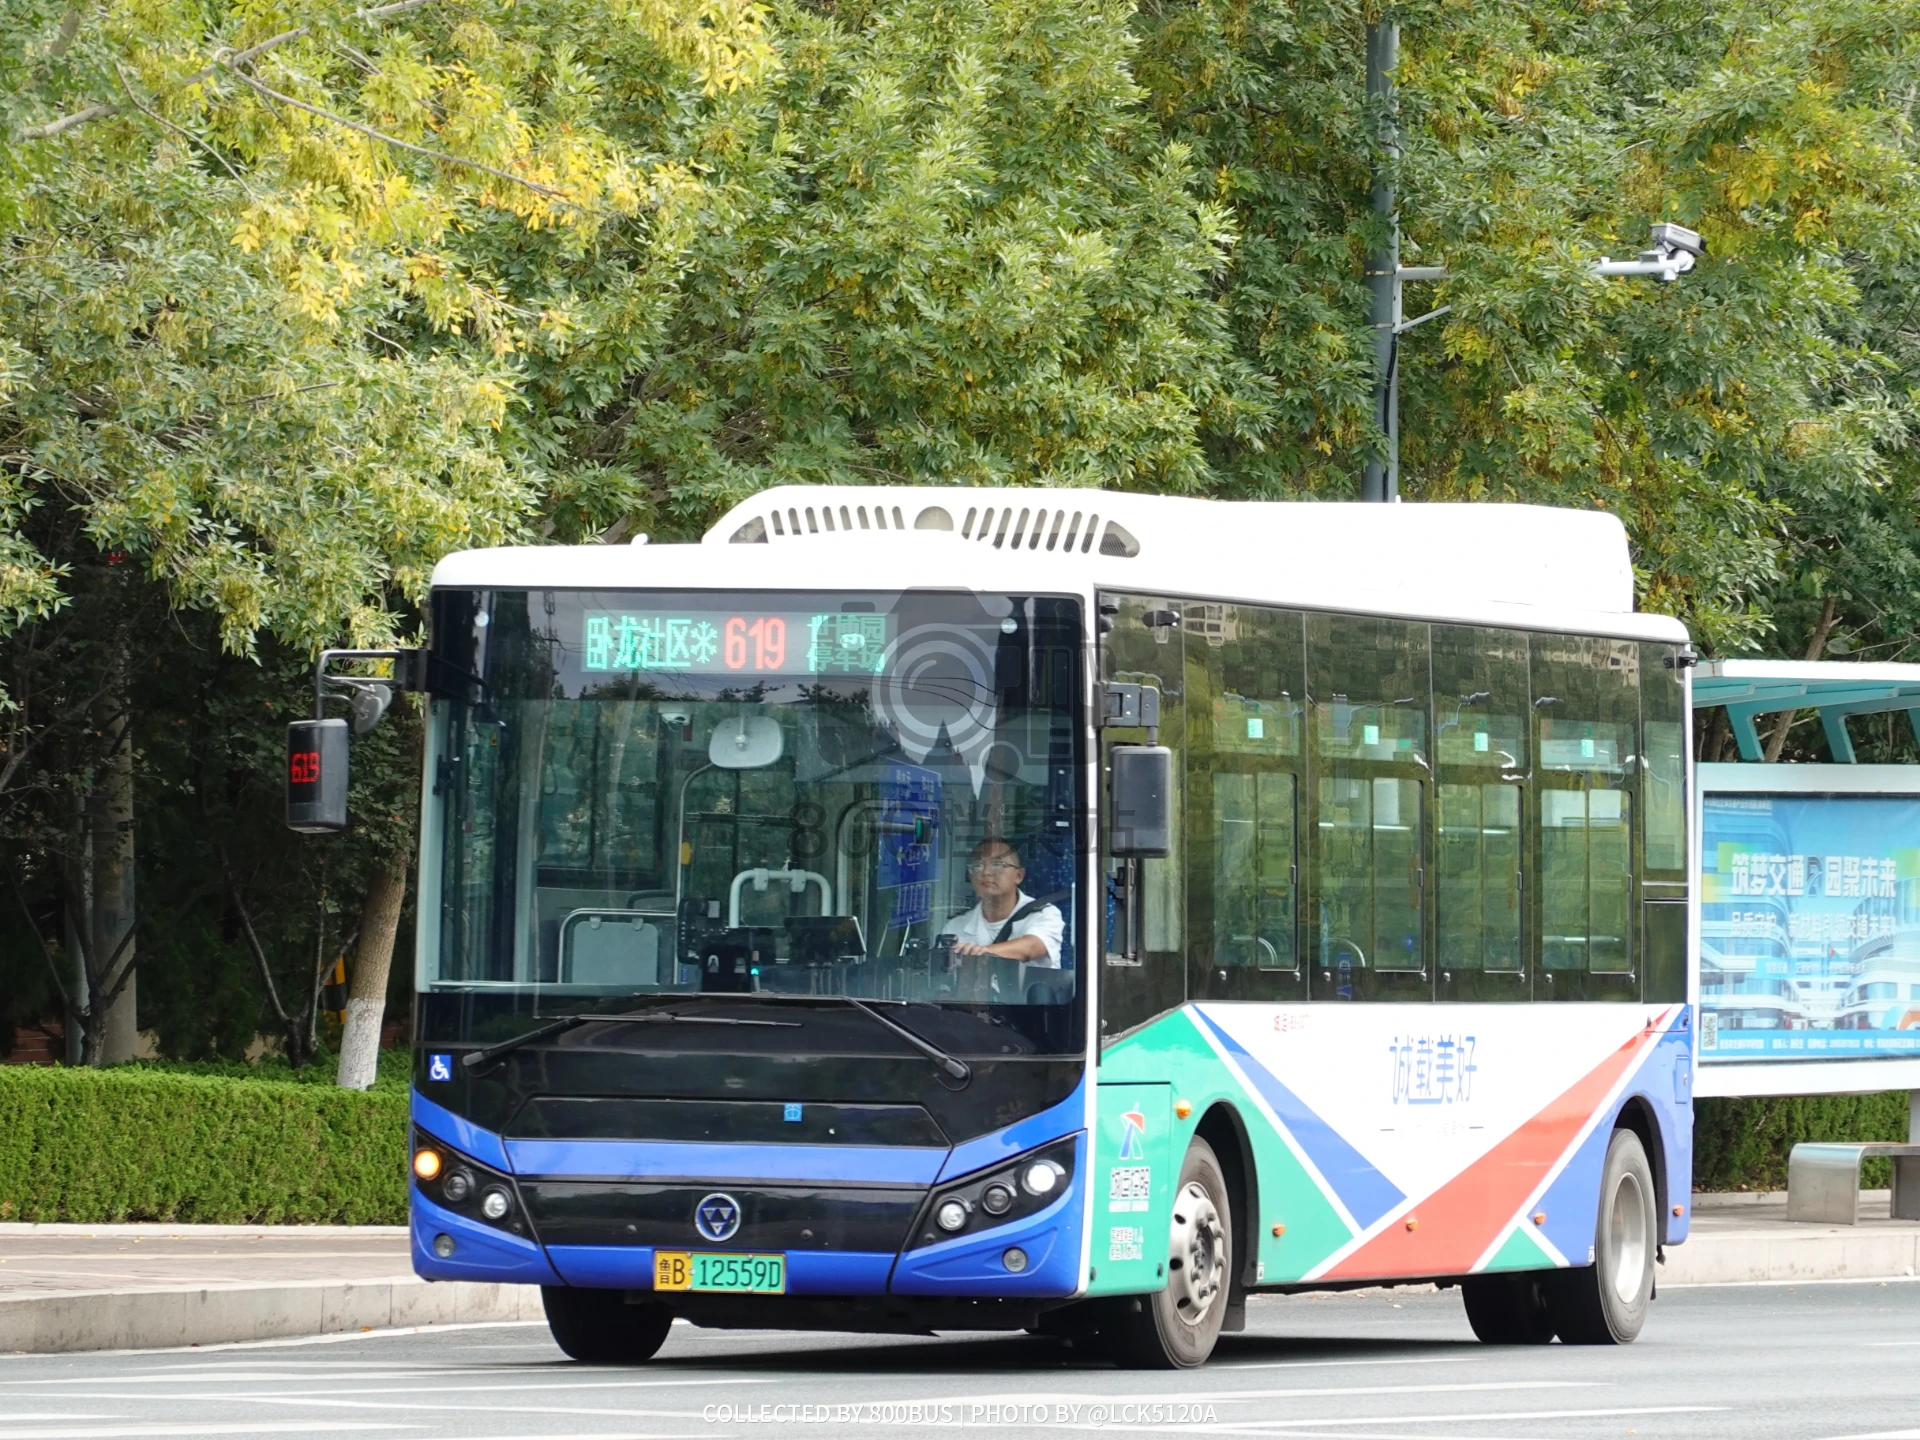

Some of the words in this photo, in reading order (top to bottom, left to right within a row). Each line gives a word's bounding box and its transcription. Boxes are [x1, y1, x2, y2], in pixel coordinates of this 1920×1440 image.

[586, 615, 692, 670] 卧龙社区
[724, 617, 786, 670] 619
[806, 644, 886, 672] 停车场
[290, 752, 320, 783] 619
[1731, 852, 1806, 897] 筑梦交通
